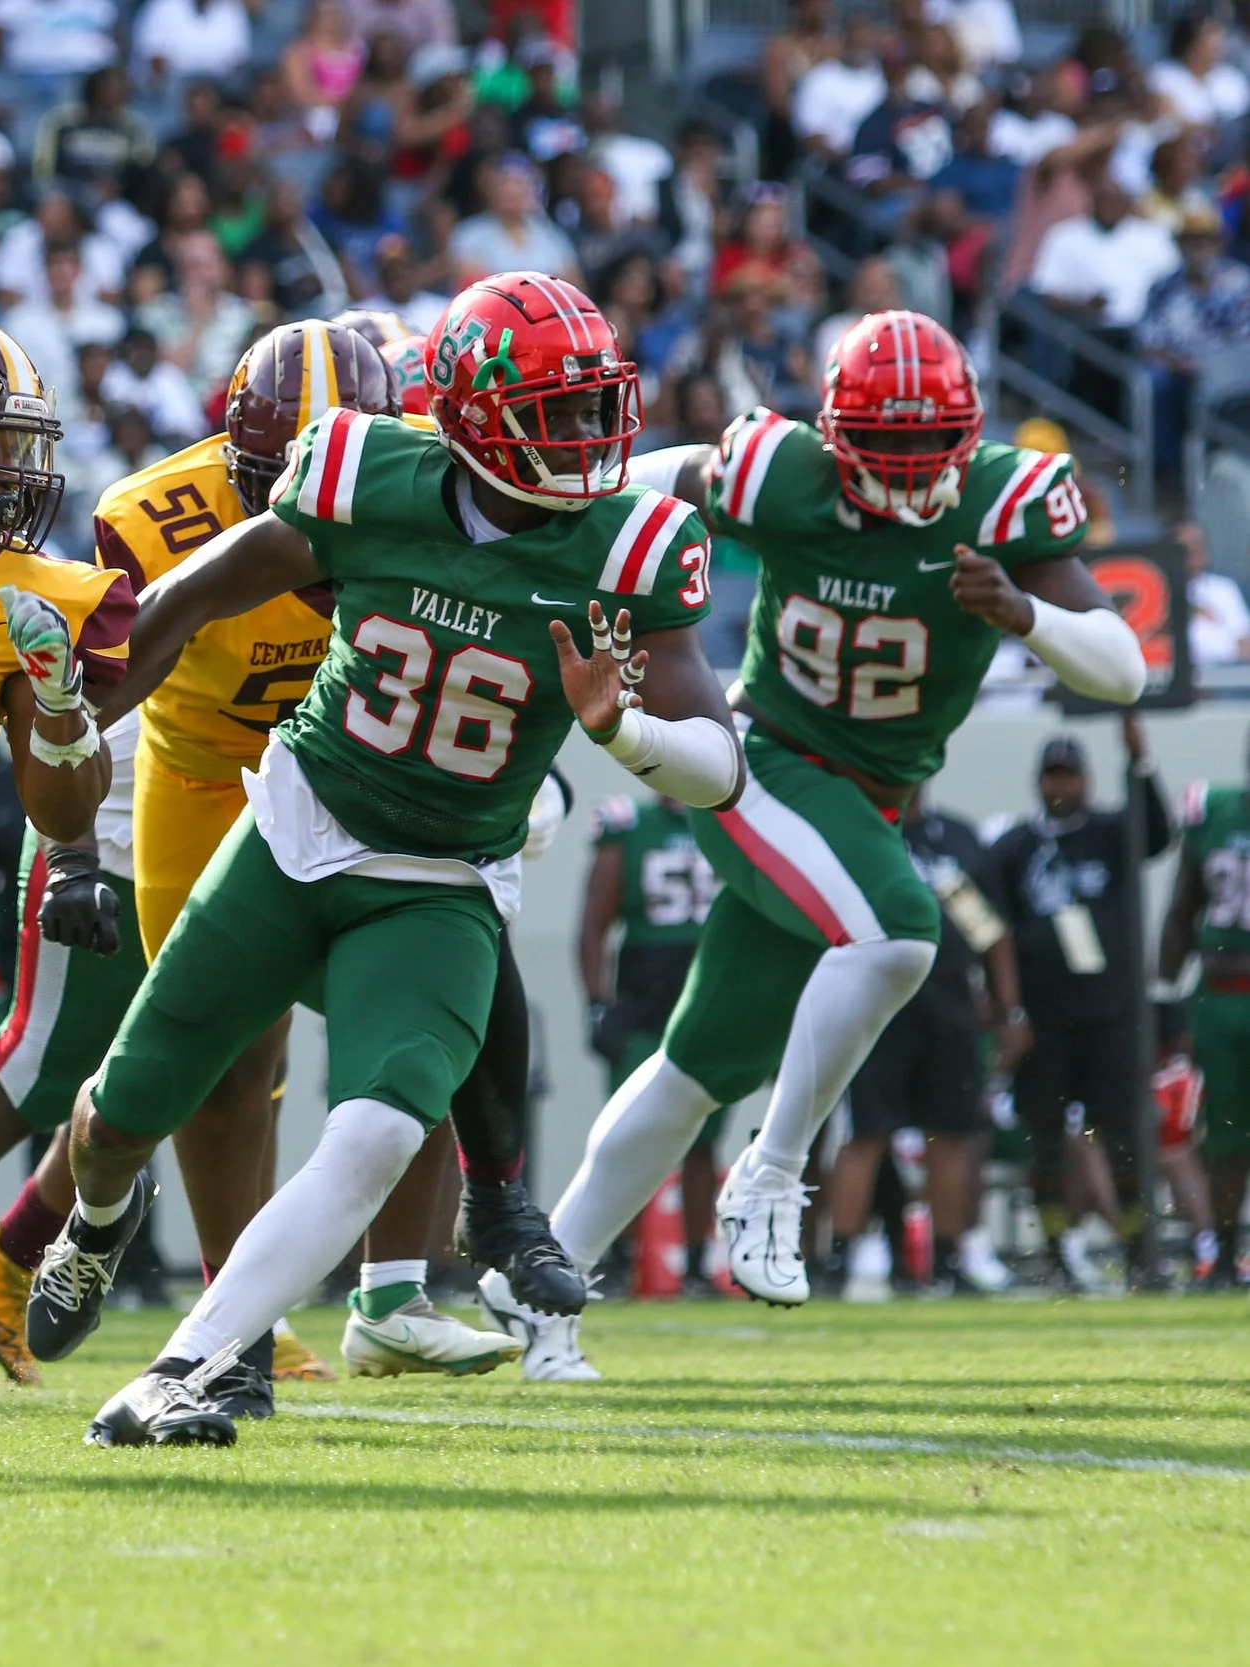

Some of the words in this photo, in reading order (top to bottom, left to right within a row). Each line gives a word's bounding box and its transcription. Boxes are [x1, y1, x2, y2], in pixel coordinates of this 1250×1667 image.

[518, 437, 543, 466] schu
[139, 483, 224, 554] 50
[678, 540, 711, 609] 3
[817, 574, 897, 612] VALLEY
[409, 586, 502, 640] VALLEY
[1086, 556, 1174, 671] 2
[776, 593, 929, 720] 92
[344, 611, 535, 782] 36
